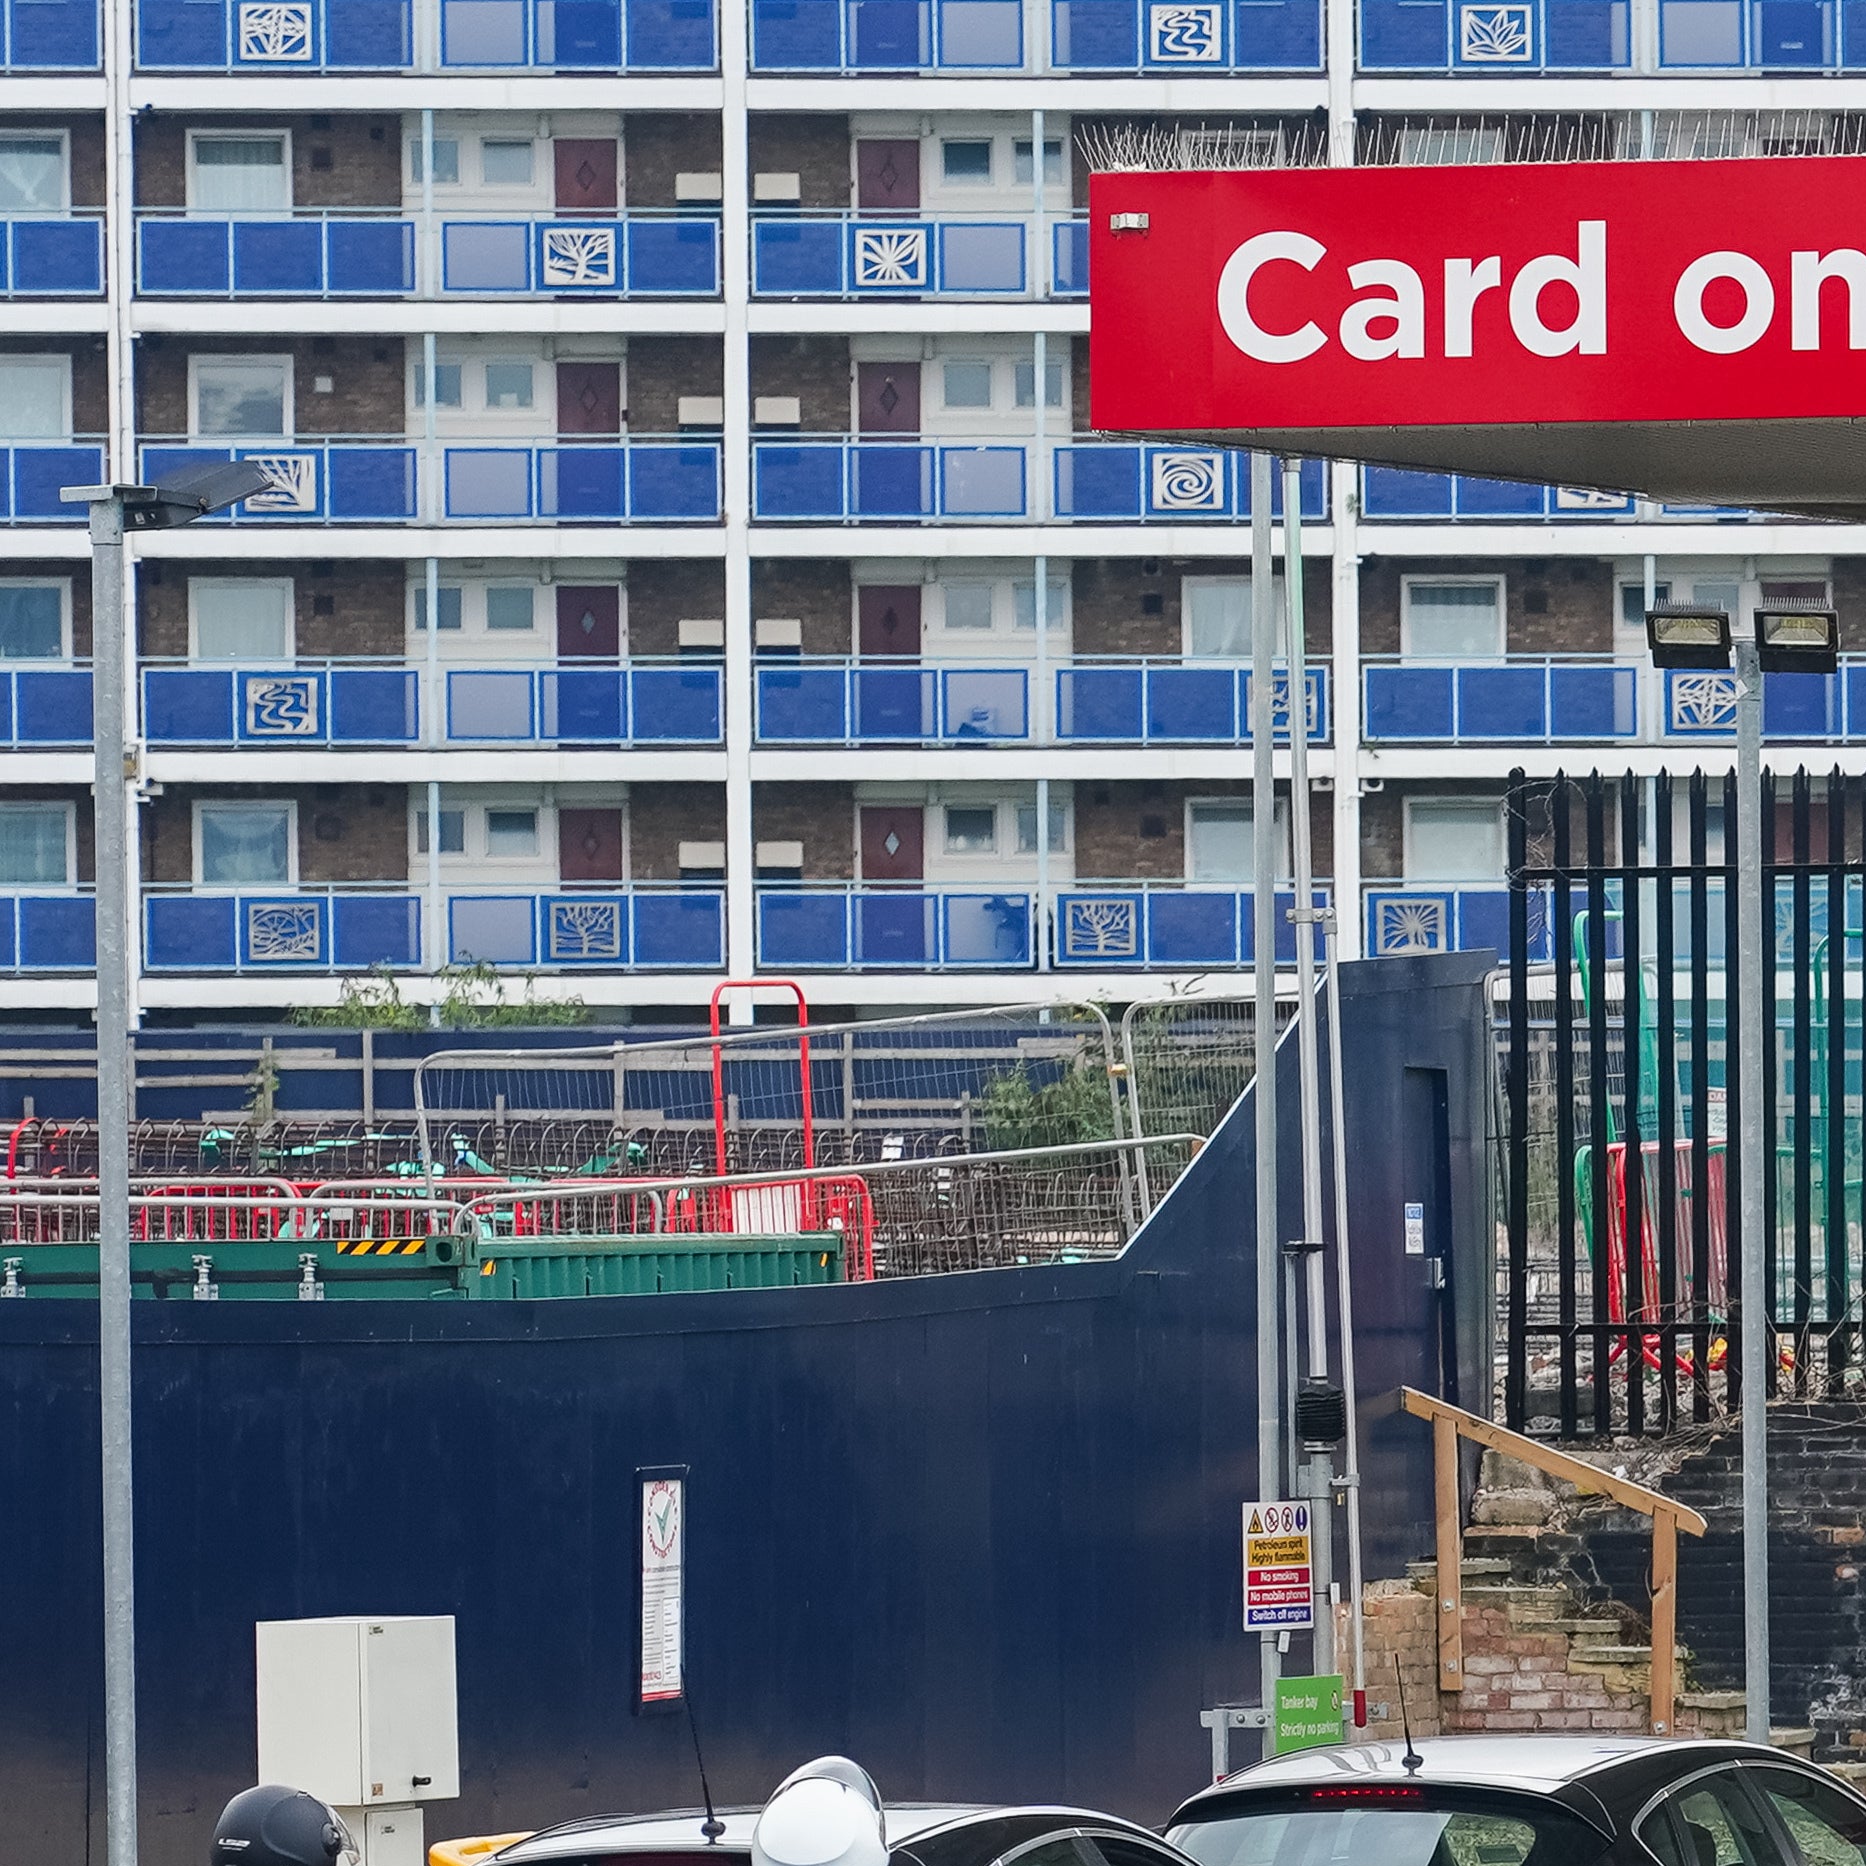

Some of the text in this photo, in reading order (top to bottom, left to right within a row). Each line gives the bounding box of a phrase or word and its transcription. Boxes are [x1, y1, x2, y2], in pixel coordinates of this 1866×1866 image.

[1216, 220, 1606, 363] Card
[1251, 1552, 1273, 1565] Highly
[1260, 1570, 1299, 1583] No smoking
[1250, 1591, 1260, 1601] No
[1261, 1591, 1285, 1601] mobile
[1252, 1609, 1277, 1621] Switch
[1281, 1694, 1318, 1710] Tanker bay
[1280, 1720, 1339, 1738] Strictly no parking
